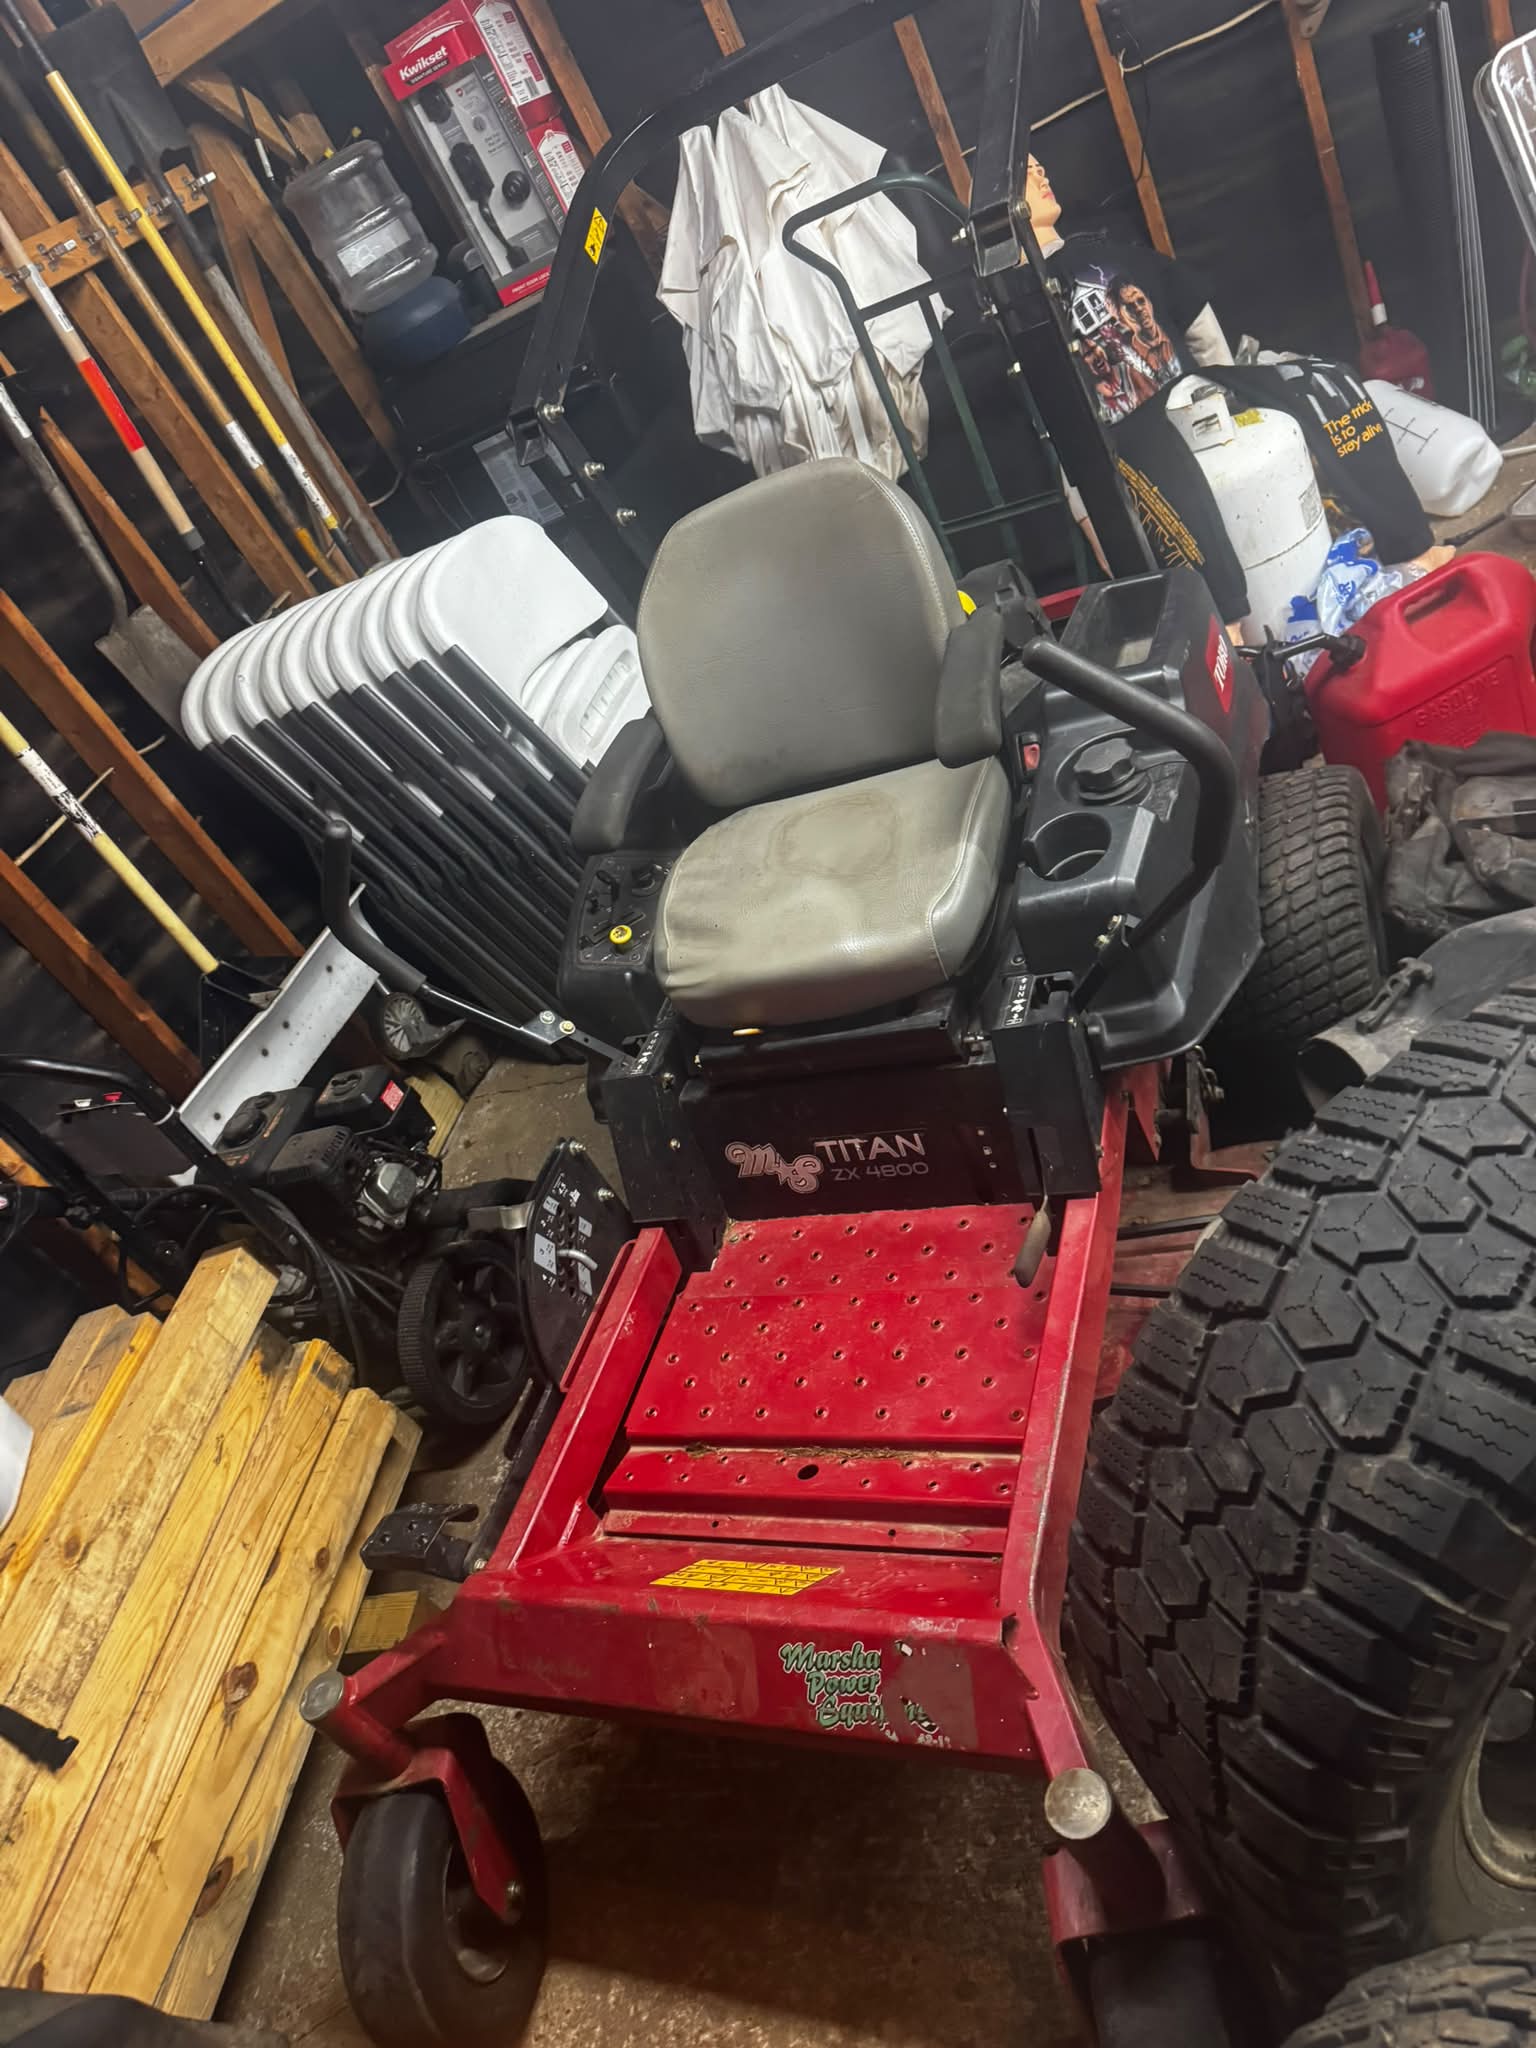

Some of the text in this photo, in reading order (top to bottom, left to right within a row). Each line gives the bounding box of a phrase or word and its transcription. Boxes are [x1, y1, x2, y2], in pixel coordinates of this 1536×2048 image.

[398, 45, 448, 81] Kwikset
[1323, 399, 1373, 435] The trick
[1329, 425, 1356, 447] is to
[1336, 435, 1360, 458] stay
[1213, 634, 1229, 694] TORO
[814, 1132, 926, 1163] TITAN
[831, 1162, 929, 1180] ZX 4800
[805, 1670, 881, 1706] Power
